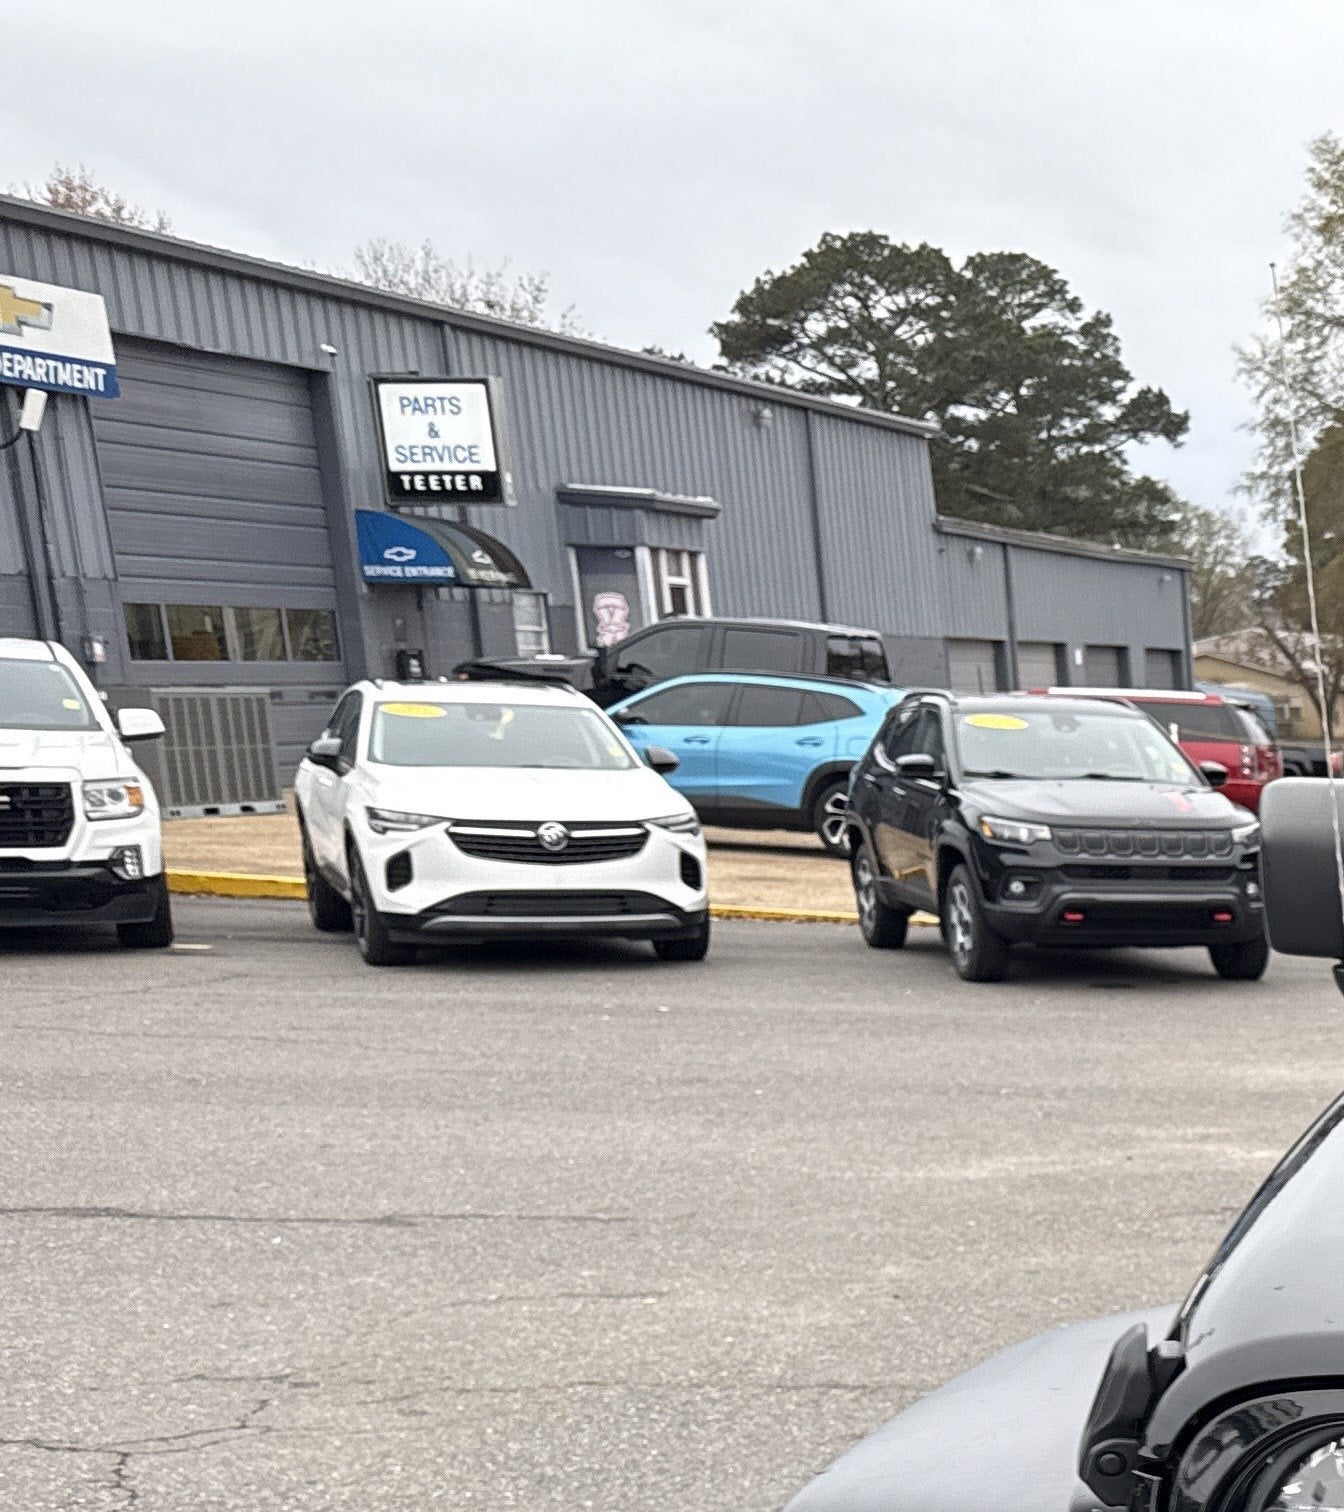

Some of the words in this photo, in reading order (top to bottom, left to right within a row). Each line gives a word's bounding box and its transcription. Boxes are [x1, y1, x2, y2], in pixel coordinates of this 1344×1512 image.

[0, 351, 107, 392] EPARTMENT
[399, 395, 462, 415] PARTS
[428, 421, 440, 439] &
[394, 444, 481, 464] SERVICE
[399, 474, 483, 491] TEETER
